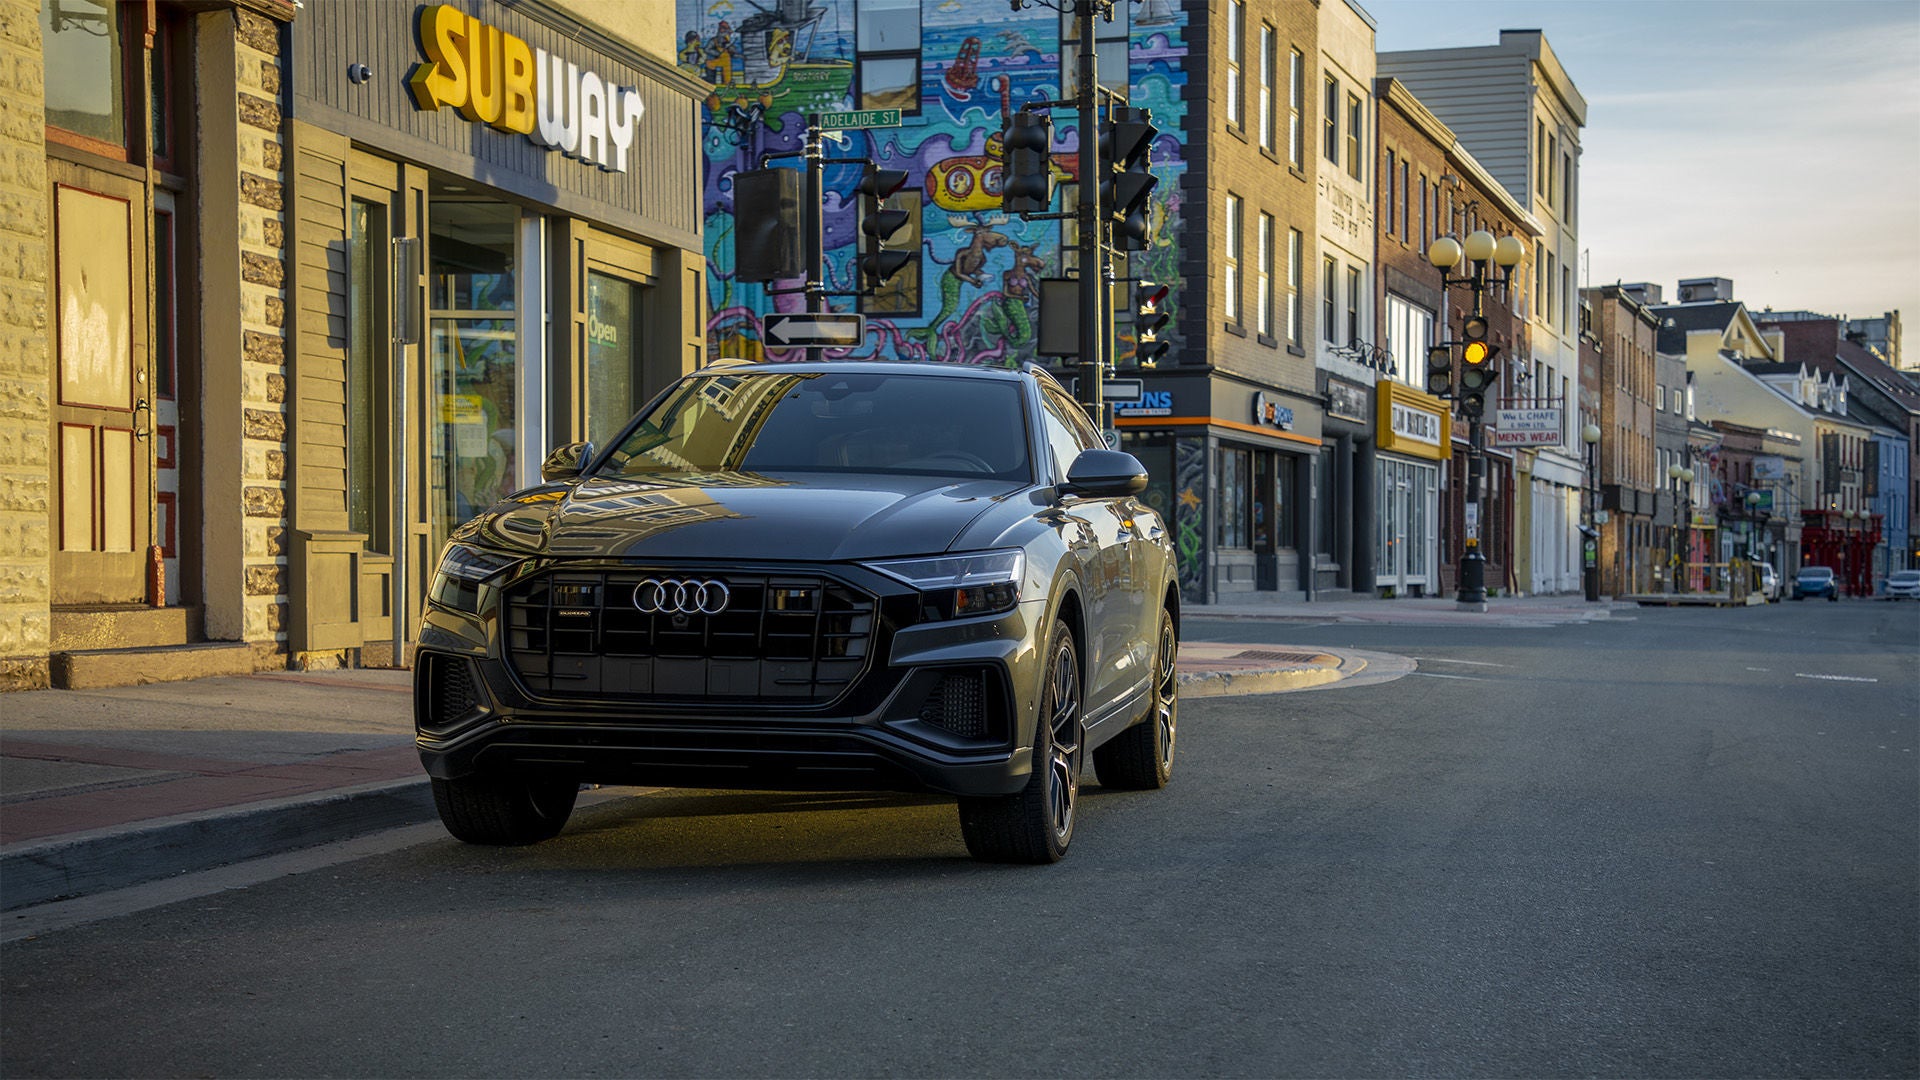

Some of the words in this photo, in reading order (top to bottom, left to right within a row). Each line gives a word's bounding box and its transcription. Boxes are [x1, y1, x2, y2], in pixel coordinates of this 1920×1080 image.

[411, 4, 645, 173] SUBWAY
[823, 112, 876, 127] ADELAIDE
[882, 111, 899, 124] ST.
[589, 314, 617, 344] Open
[1527, 411, 1555, 420] CHAFE
[1498, 432, 1526, 442] MEN'S
[1531, 432, 1558, 442] WEAR
